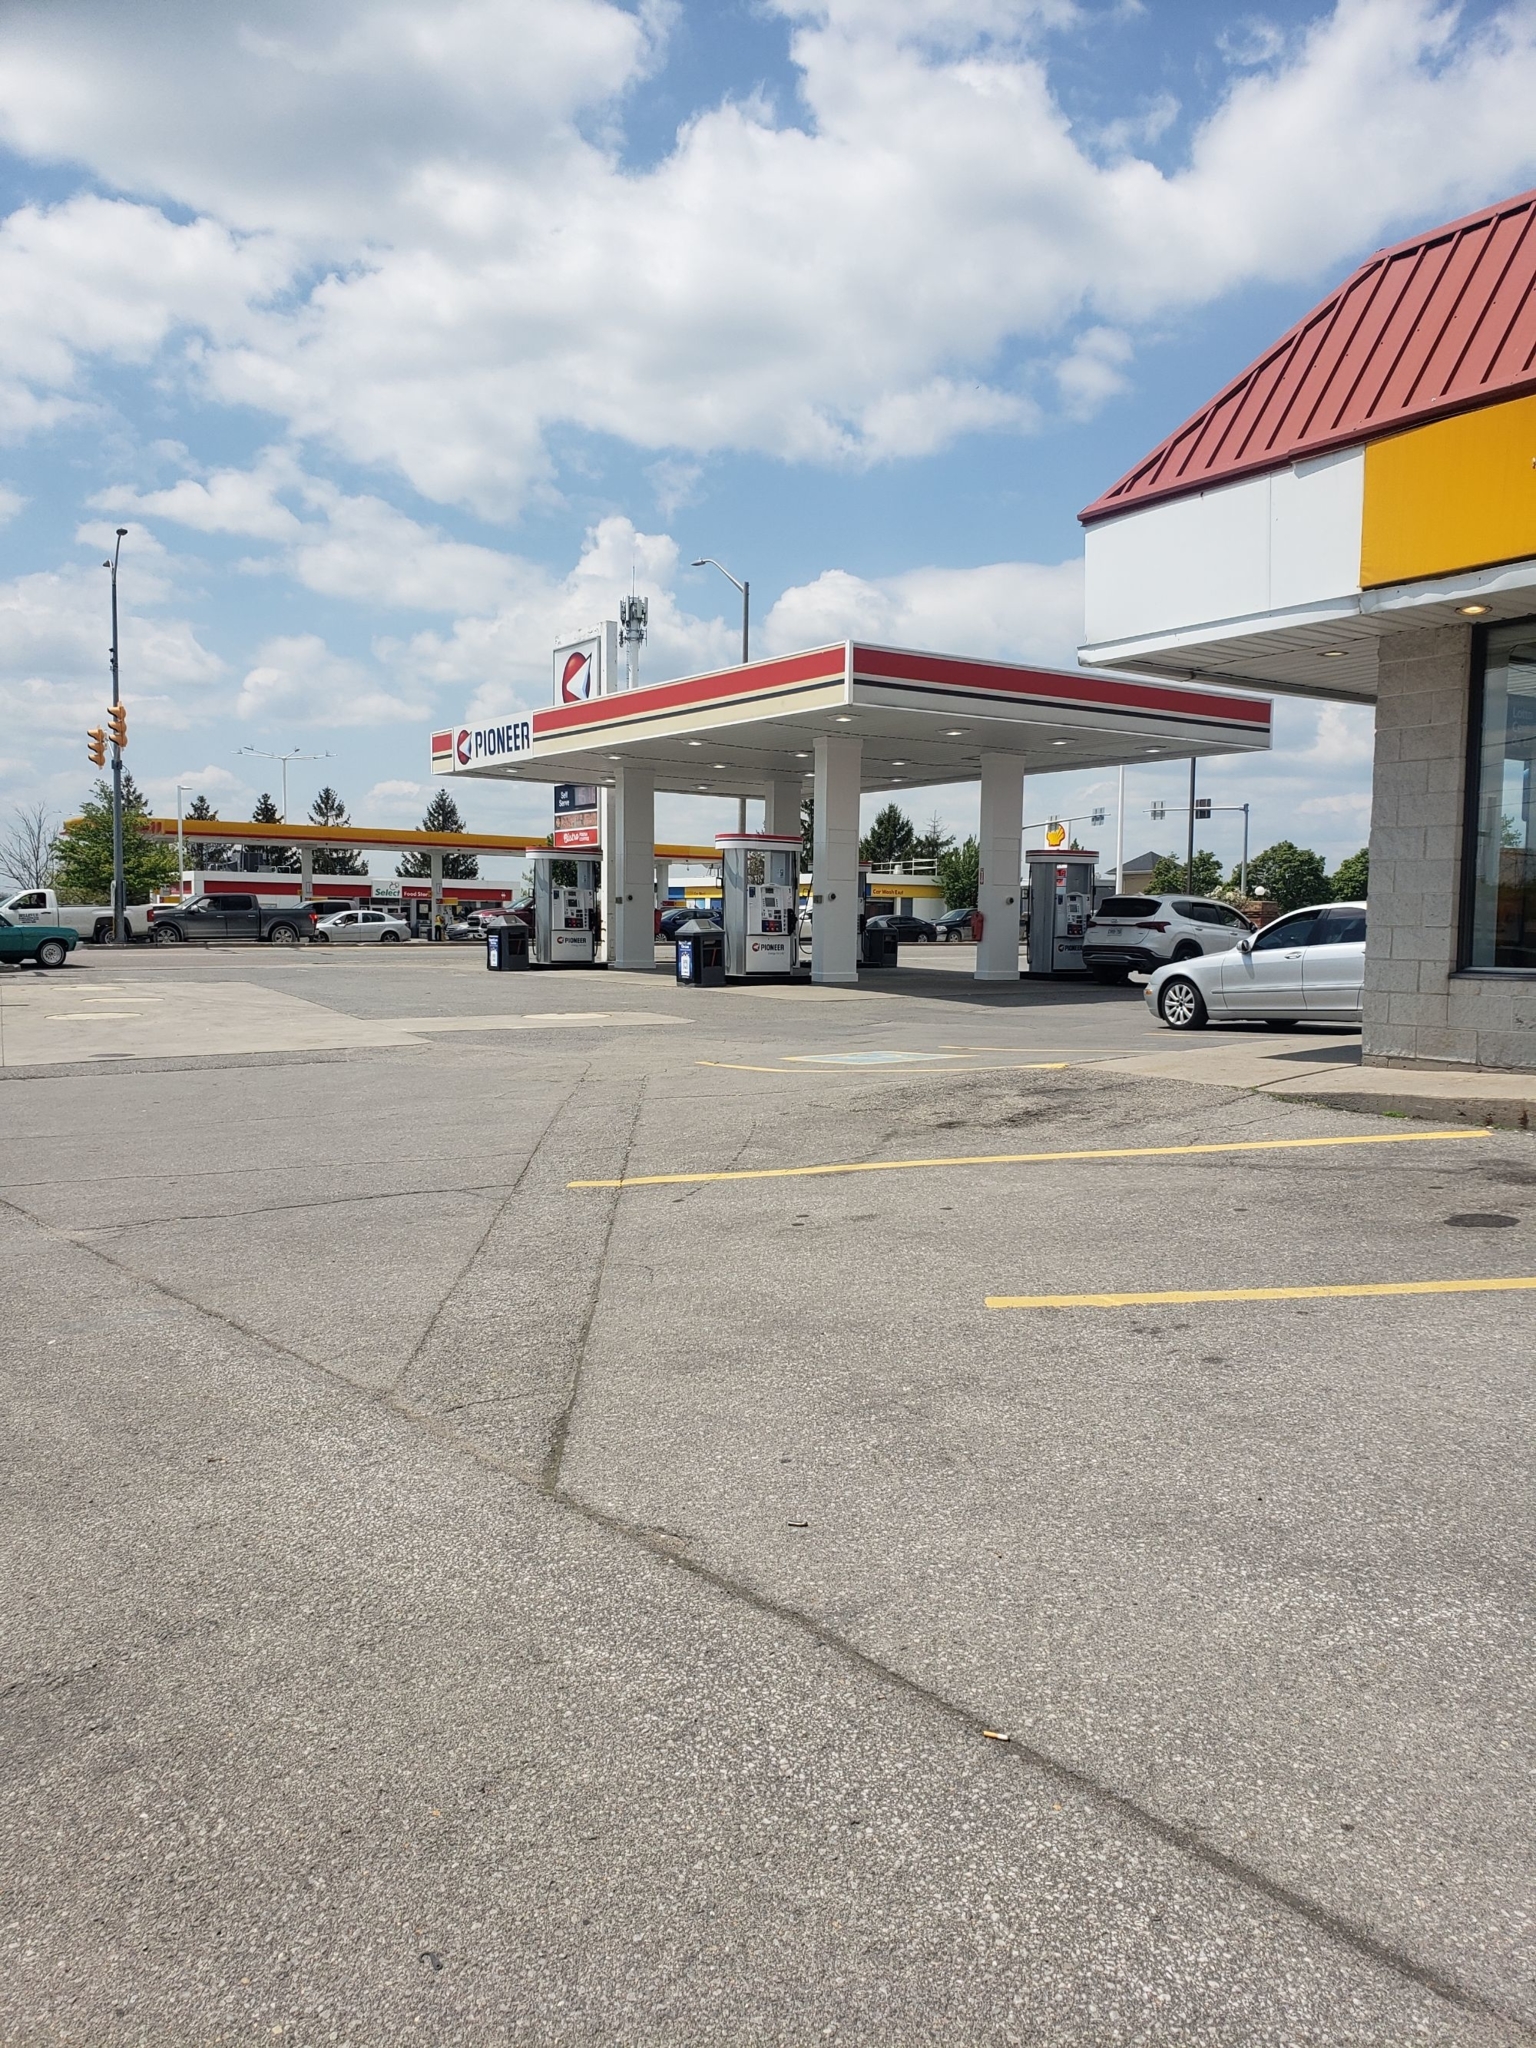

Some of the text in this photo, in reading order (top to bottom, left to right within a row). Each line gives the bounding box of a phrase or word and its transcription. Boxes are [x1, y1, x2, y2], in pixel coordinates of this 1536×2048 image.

[474, 722, 530, 758] PIONEER
[560, 791, 569, 799] Self
[558, 799, 570, 807] Serve
[375, 888, 400, 897] Select
